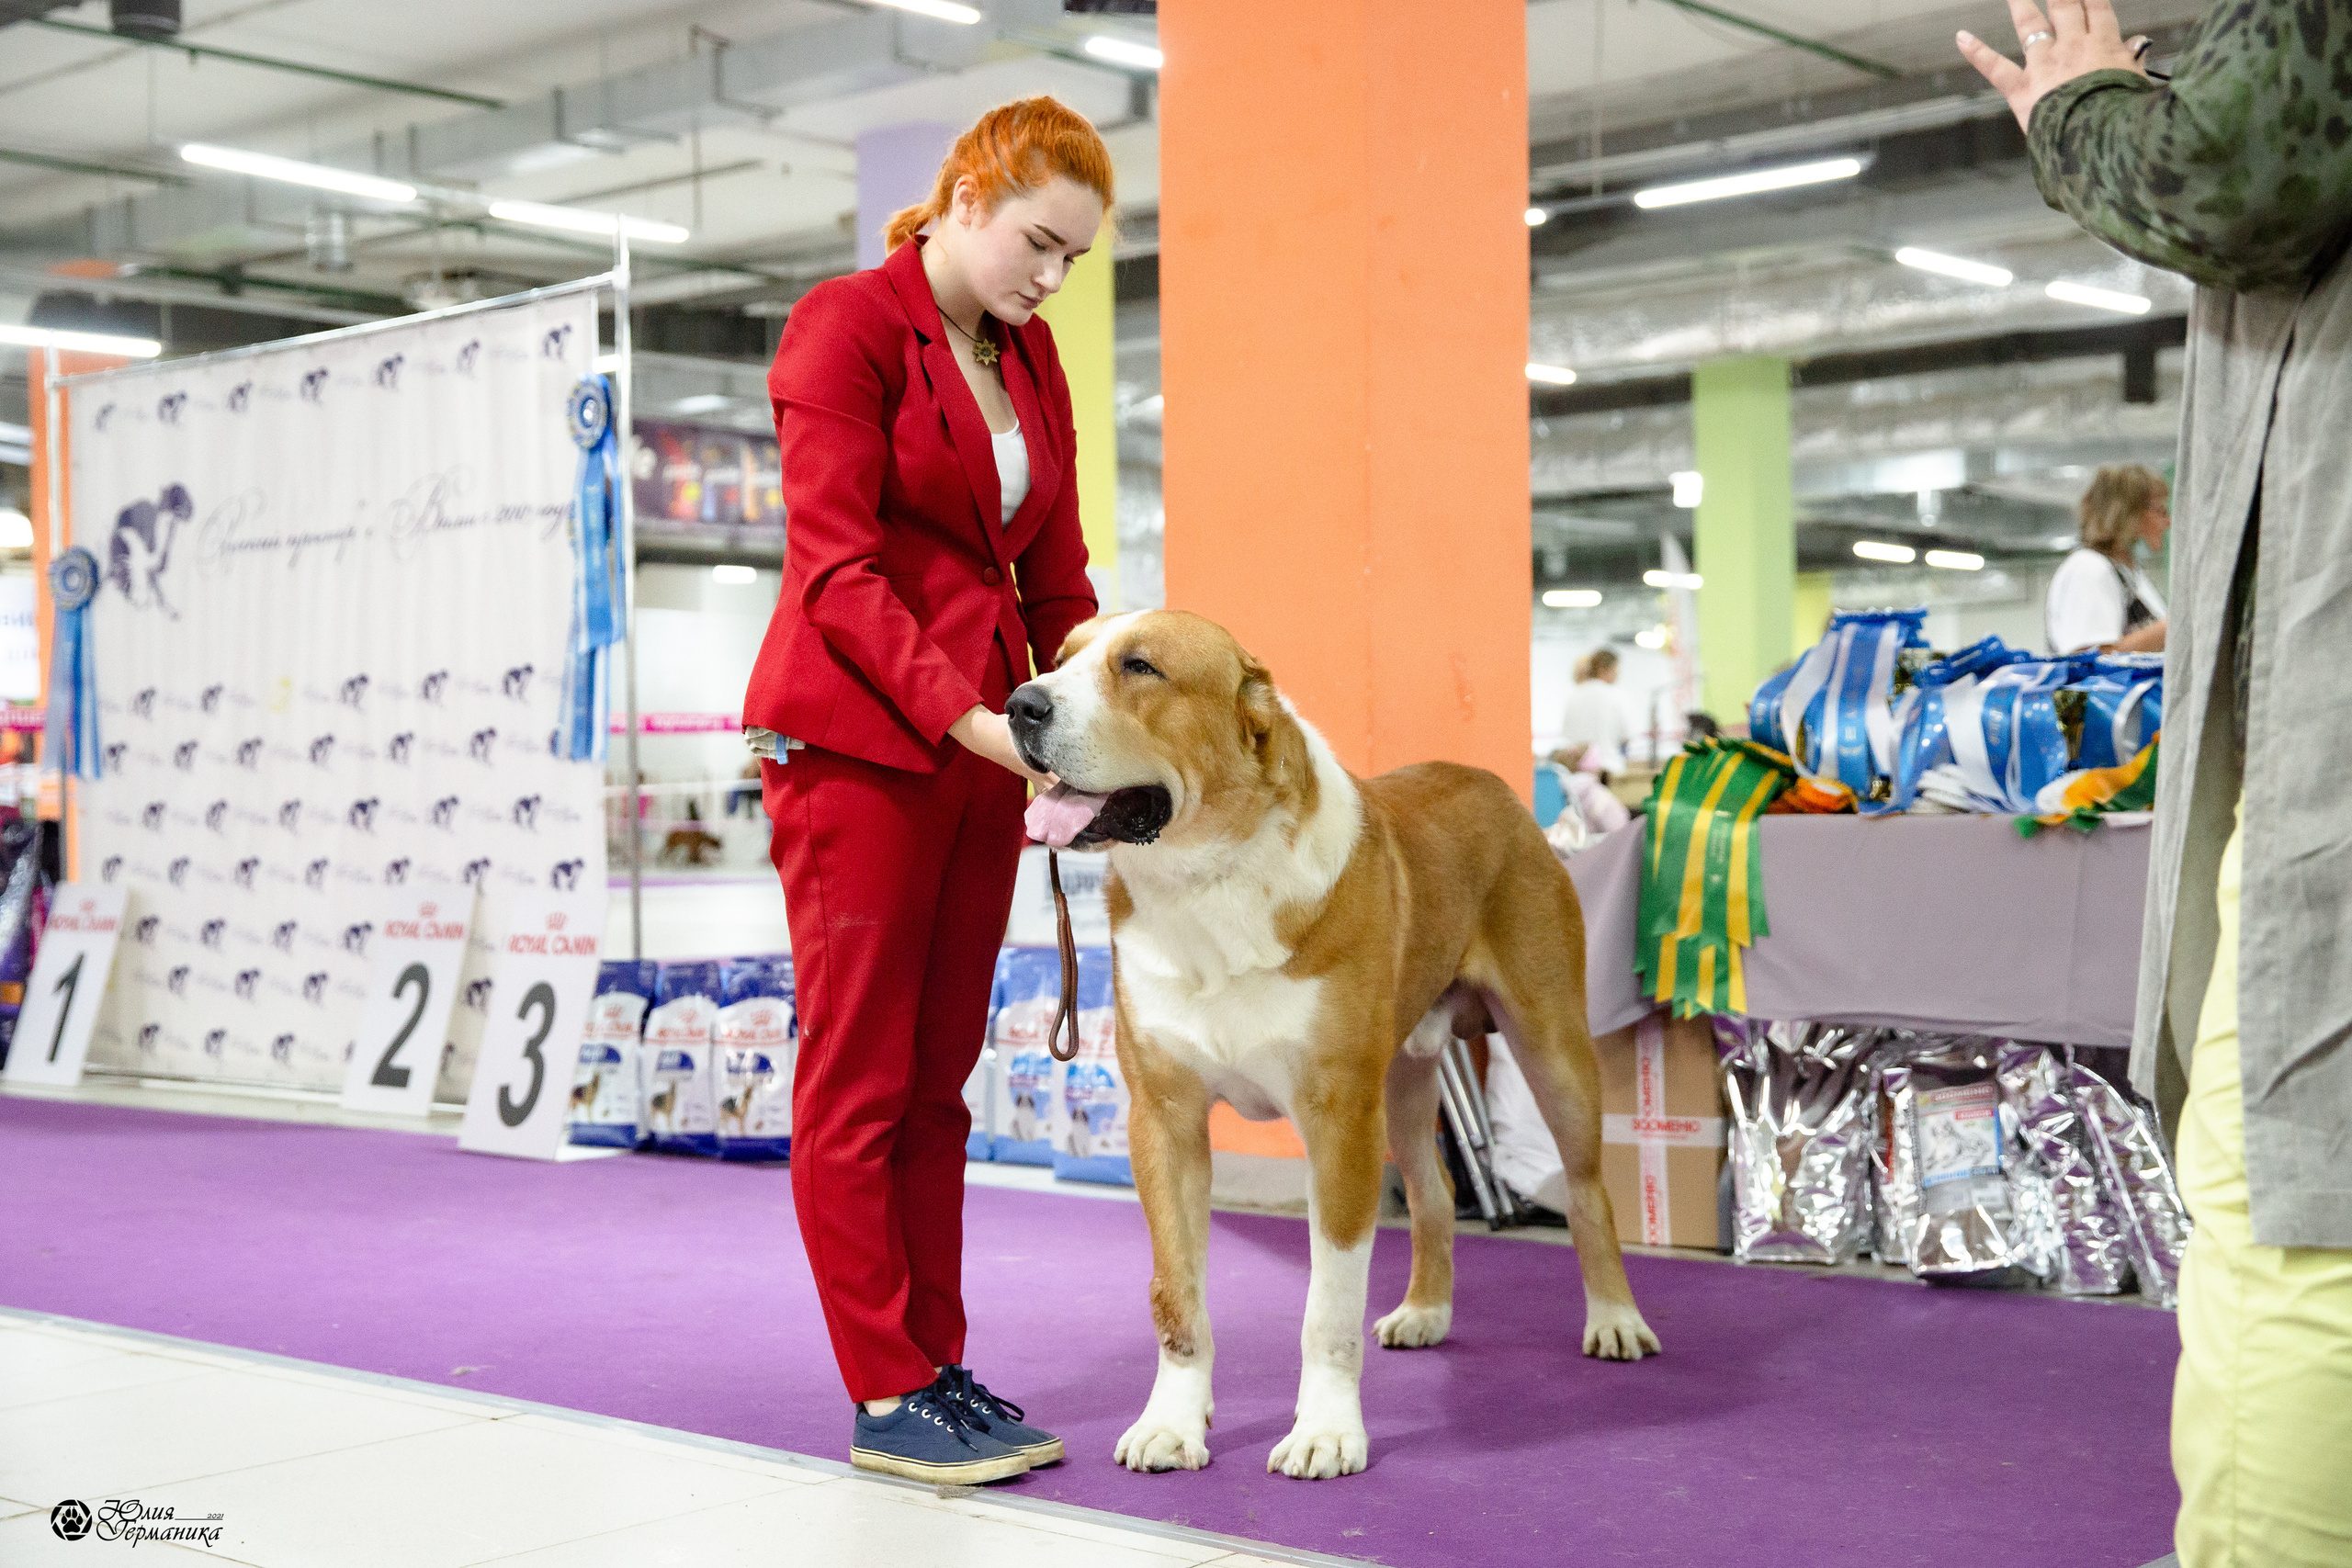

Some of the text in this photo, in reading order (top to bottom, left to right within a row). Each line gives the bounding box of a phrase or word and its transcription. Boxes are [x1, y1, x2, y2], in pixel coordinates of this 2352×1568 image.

[508, 933, 597, 955] ROYAL CANIN
[51, 950, 85, 1062] 1
[370, 961, 431, 1088] 2
[498, 981, 556, 1127] 3
